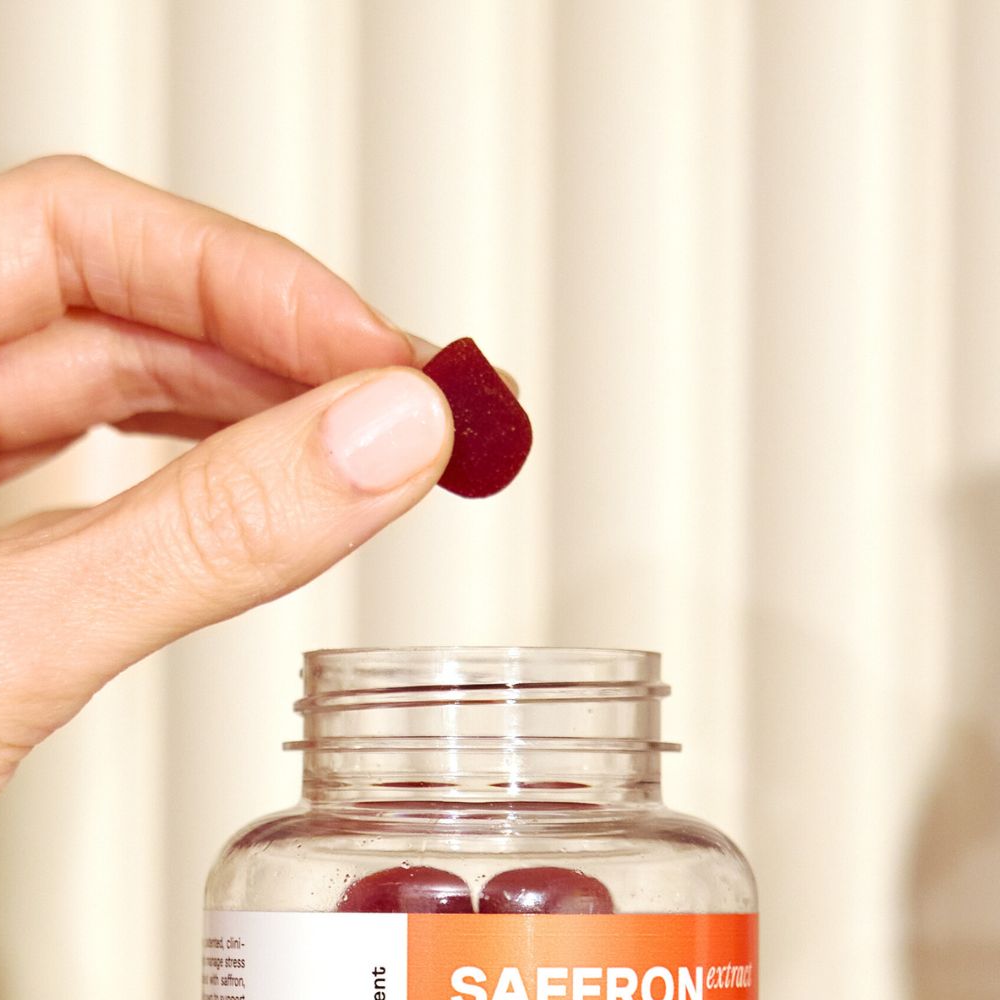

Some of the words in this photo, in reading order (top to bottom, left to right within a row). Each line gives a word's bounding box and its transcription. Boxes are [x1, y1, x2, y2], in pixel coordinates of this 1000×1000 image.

[225, 957, 246, 969] stress
[220, 974, 246, 989] saffron,
[706, 961, 752, 990] extract
